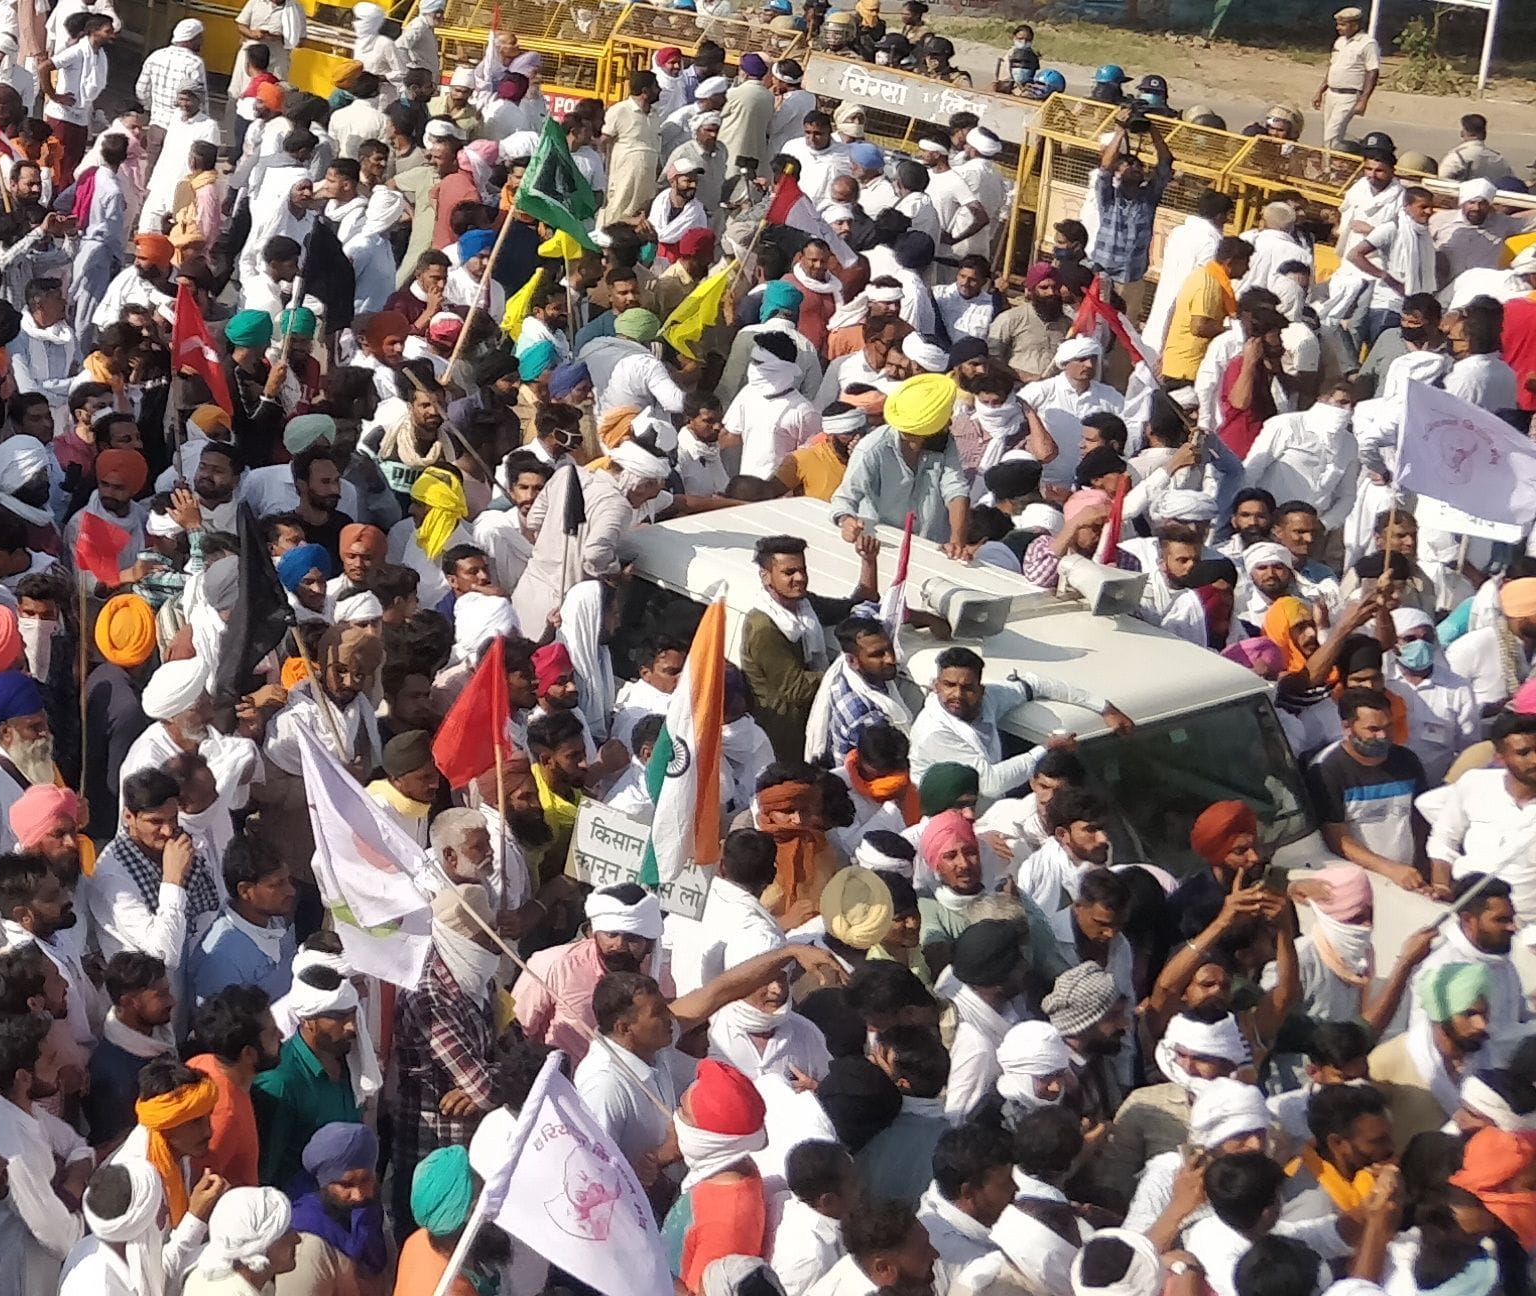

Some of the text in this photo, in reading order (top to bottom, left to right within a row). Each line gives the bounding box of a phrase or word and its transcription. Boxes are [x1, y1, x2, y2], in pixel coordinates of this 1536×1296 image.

[840, 64, 908, 105] सिरसा
[590, 817, 645, 856] किसान
[575, 849, 623, 885] कानून
[680, 883, 703, 907] लो
